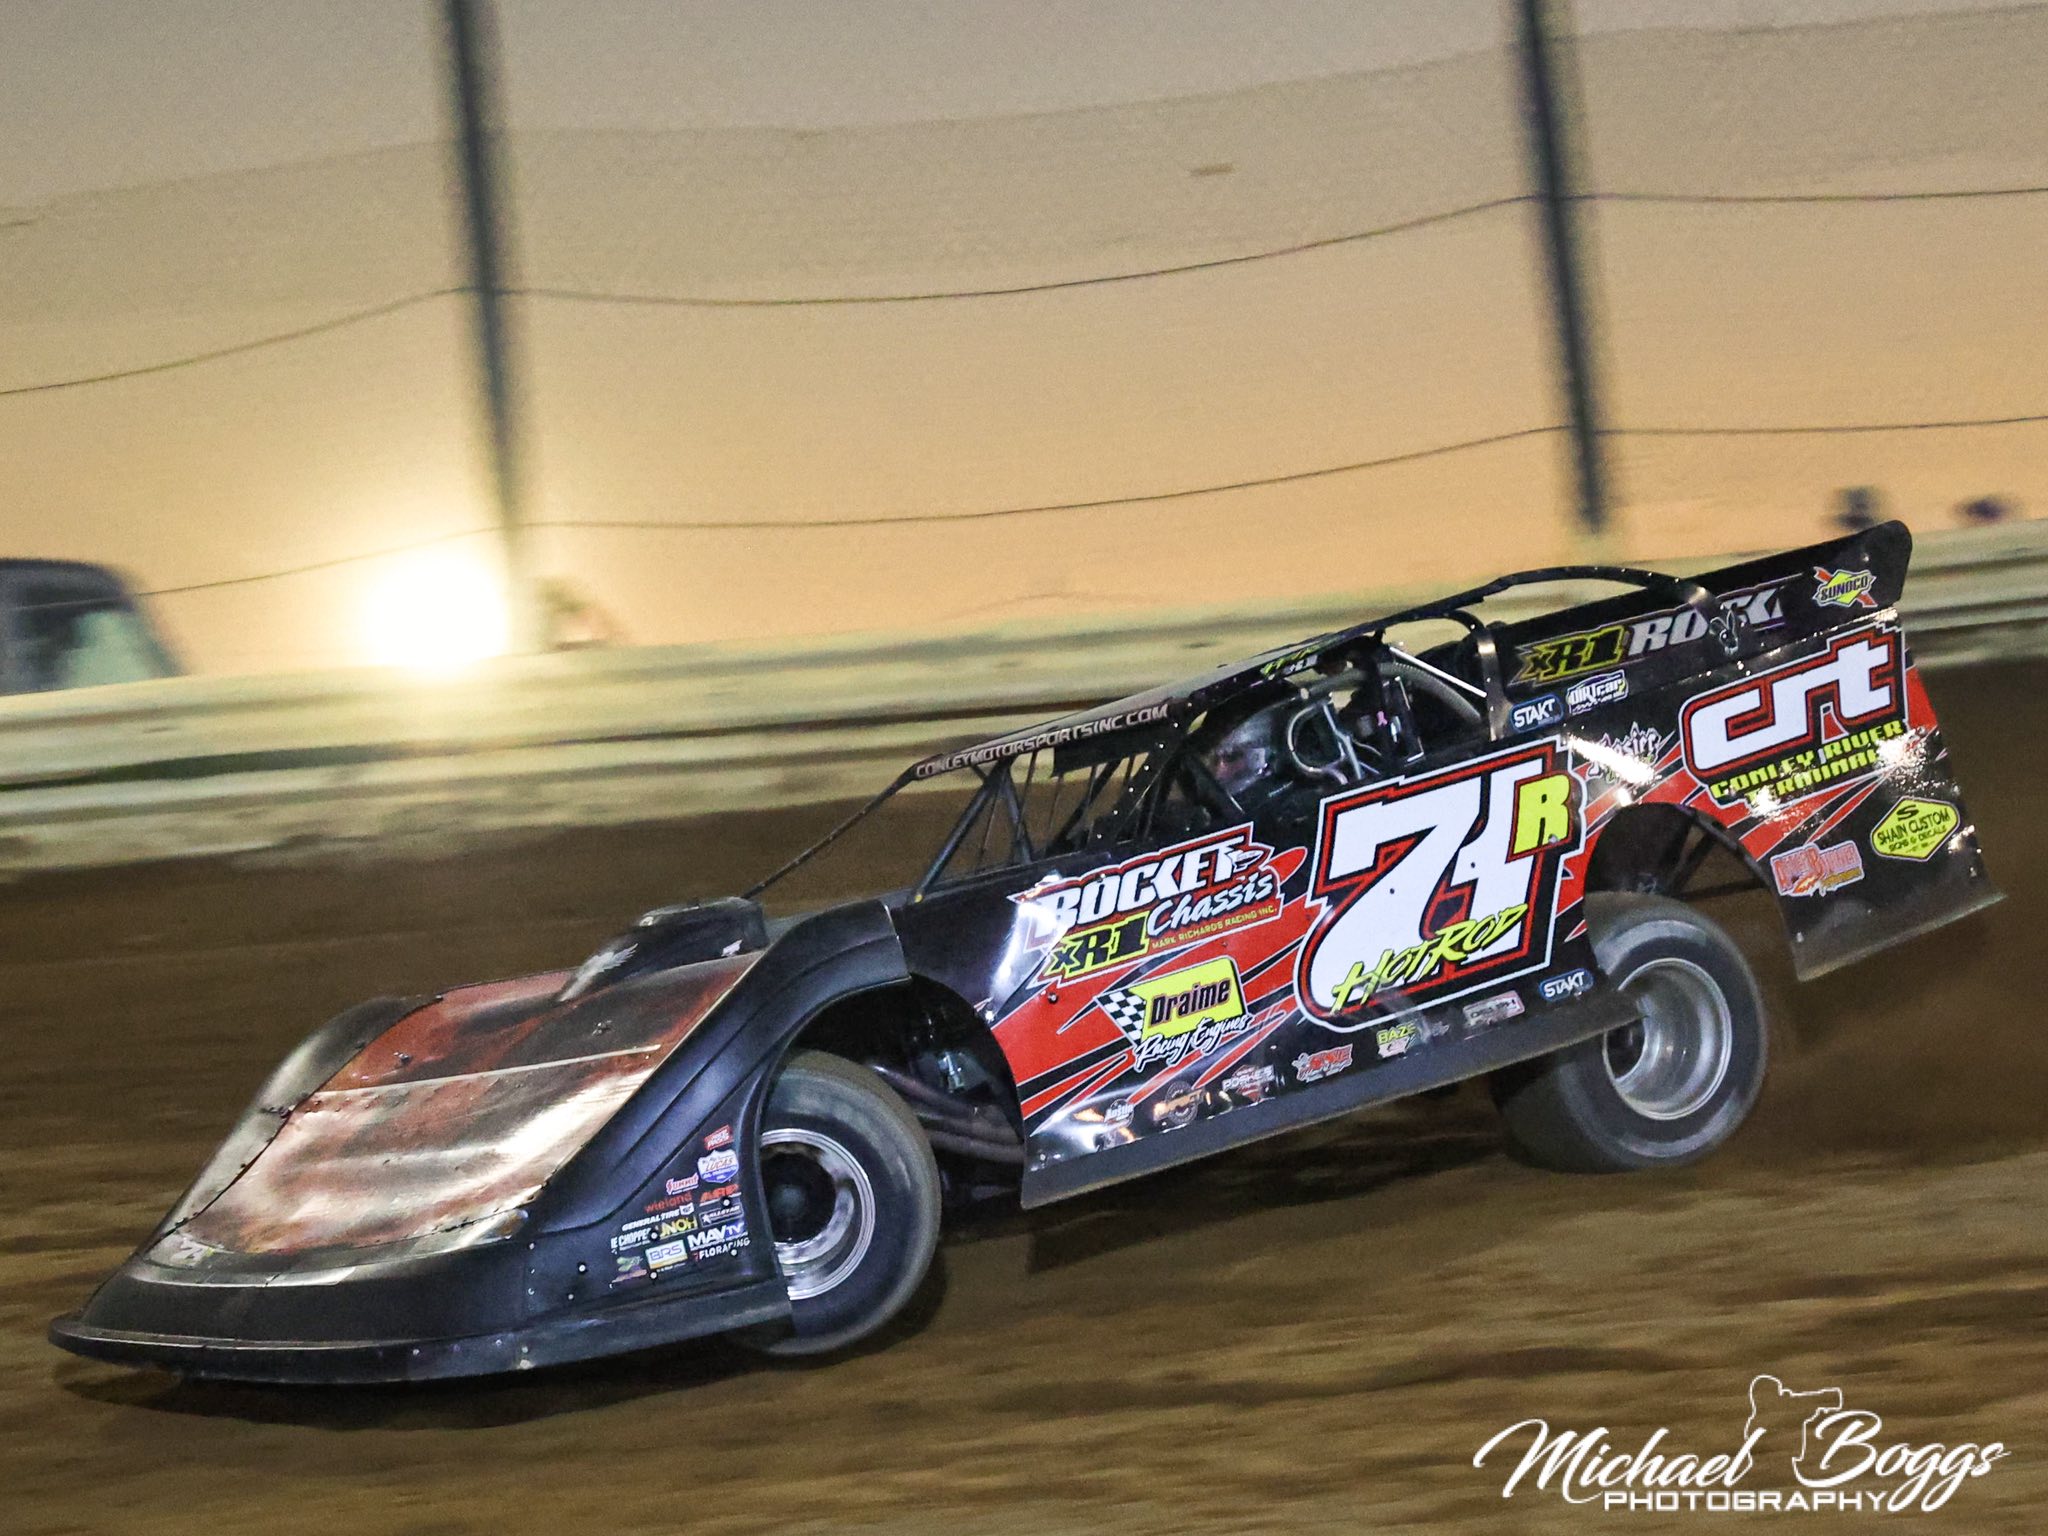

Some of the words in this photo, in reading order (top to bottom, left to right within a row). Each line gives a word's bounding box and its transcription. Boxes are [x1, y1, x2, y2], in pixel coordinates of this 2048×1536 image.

[1819, 574, 1870, 601] SUNOCO
[1514, 698, 1556, 728] STAKT
[1823, 720, 1903, 760] RIVER
[1908, 807, 1951, 833] CUSTOM
[1021, 836, 1245, 939] ROCKET
[1147, 872, 1273, 936] Chassis
[1178, 921, 1224, 940] RICHARDS
[1224, 911, 1257, 927] RACING
[1544, 971, 1585, 998] STAKT
[1148, 977, 1232, 1028] Draime
[1135, 1033, 1190, 1070] Racing
[1190, 1016, 1250, 1055] Engines
[622, 1214, 660, 1231] GENERAL
